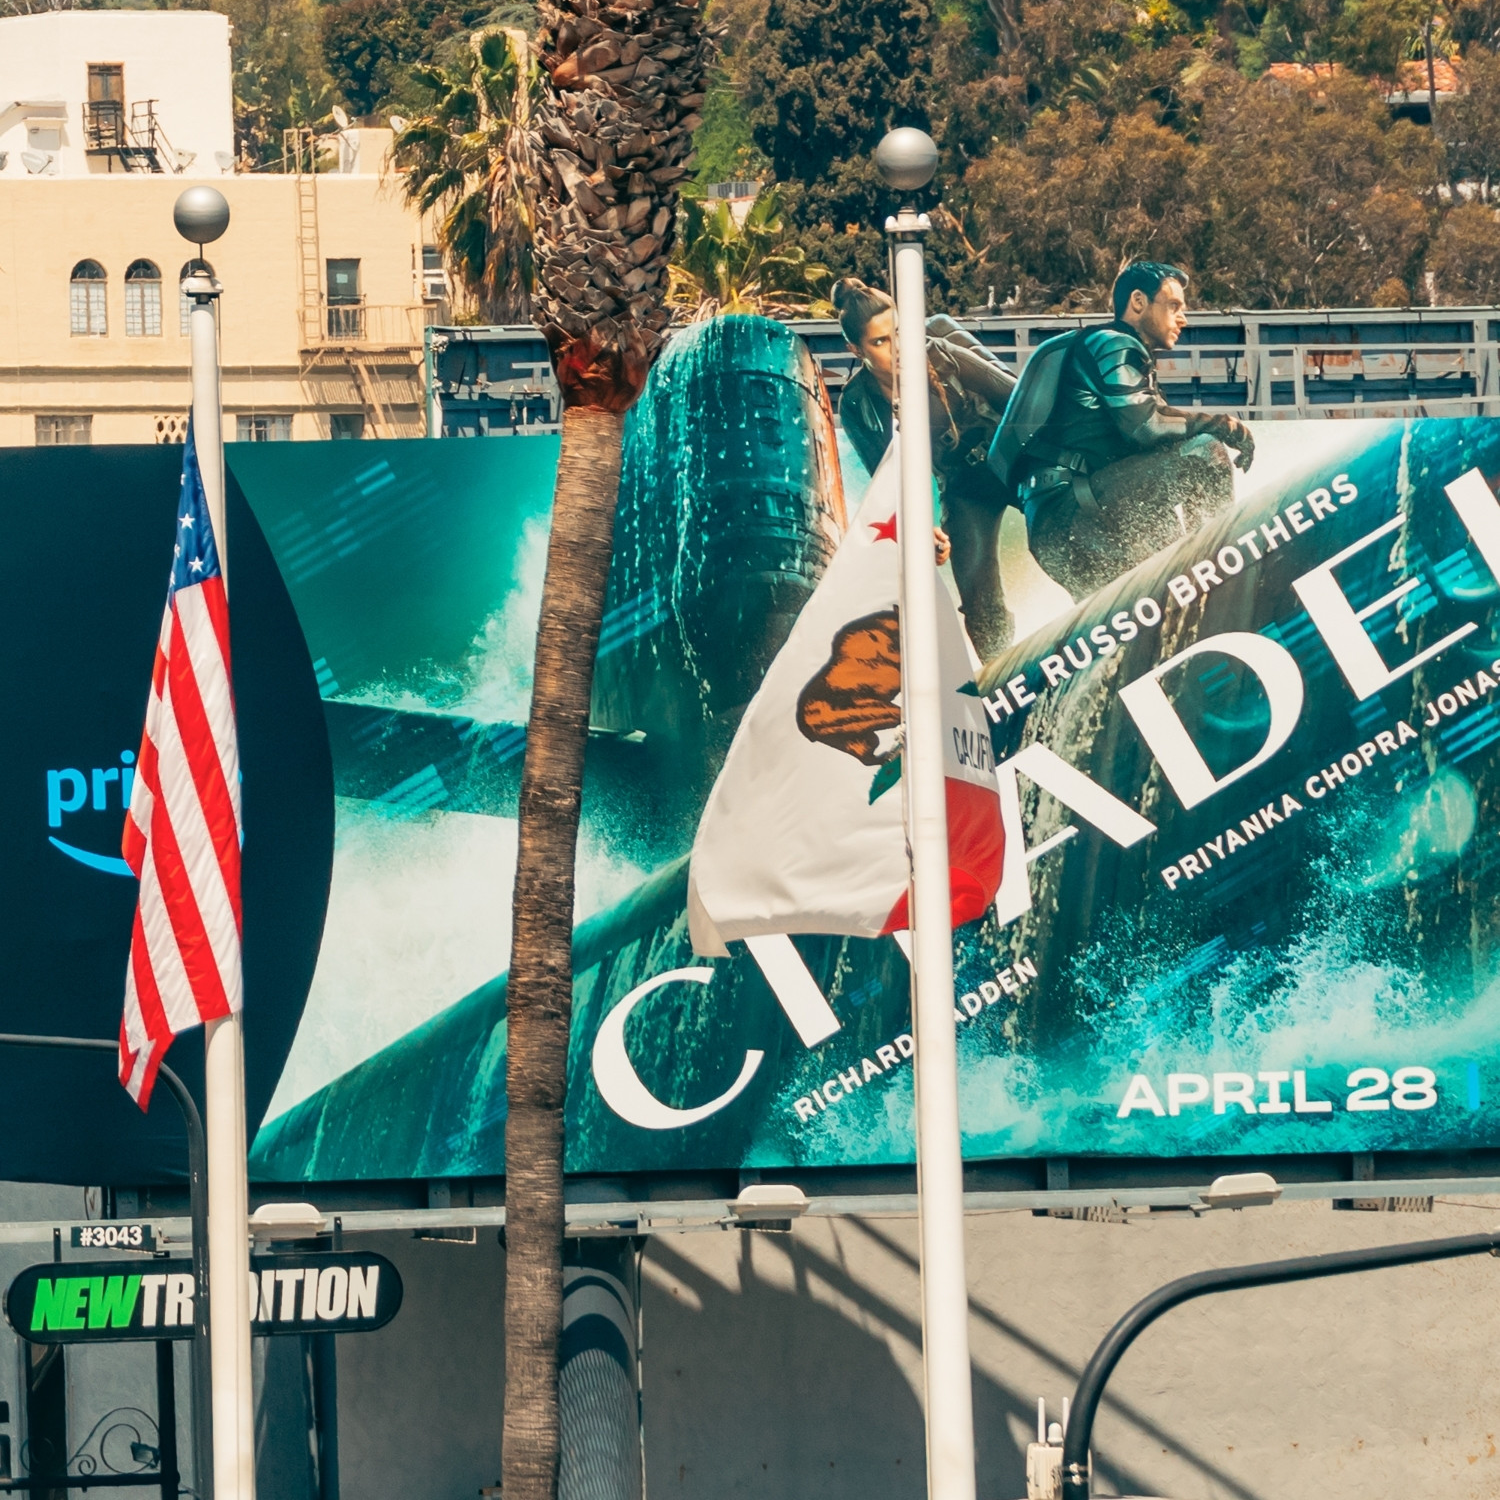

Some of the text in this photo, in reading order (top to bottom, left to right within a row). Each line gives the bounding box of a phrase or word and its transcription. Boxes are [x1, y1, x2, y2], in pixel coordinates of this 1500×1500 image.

[981, 473, 1359, 723] HE RUSSO BROTHERS
[592, 467, 1500, 1129] CIADE
[1161, 795, 1303, 891] PRIYANKA
[1305, 721, 1418, 800] CHOPRA
[793, 956, 1038, 1122] RICHARD ADDEN
[1116, 1066, 1438, 1118] APRIL 28
[30, 1265, 380, 1331] NEWTRITION
[80, 1226, 143, 1247] #3043
